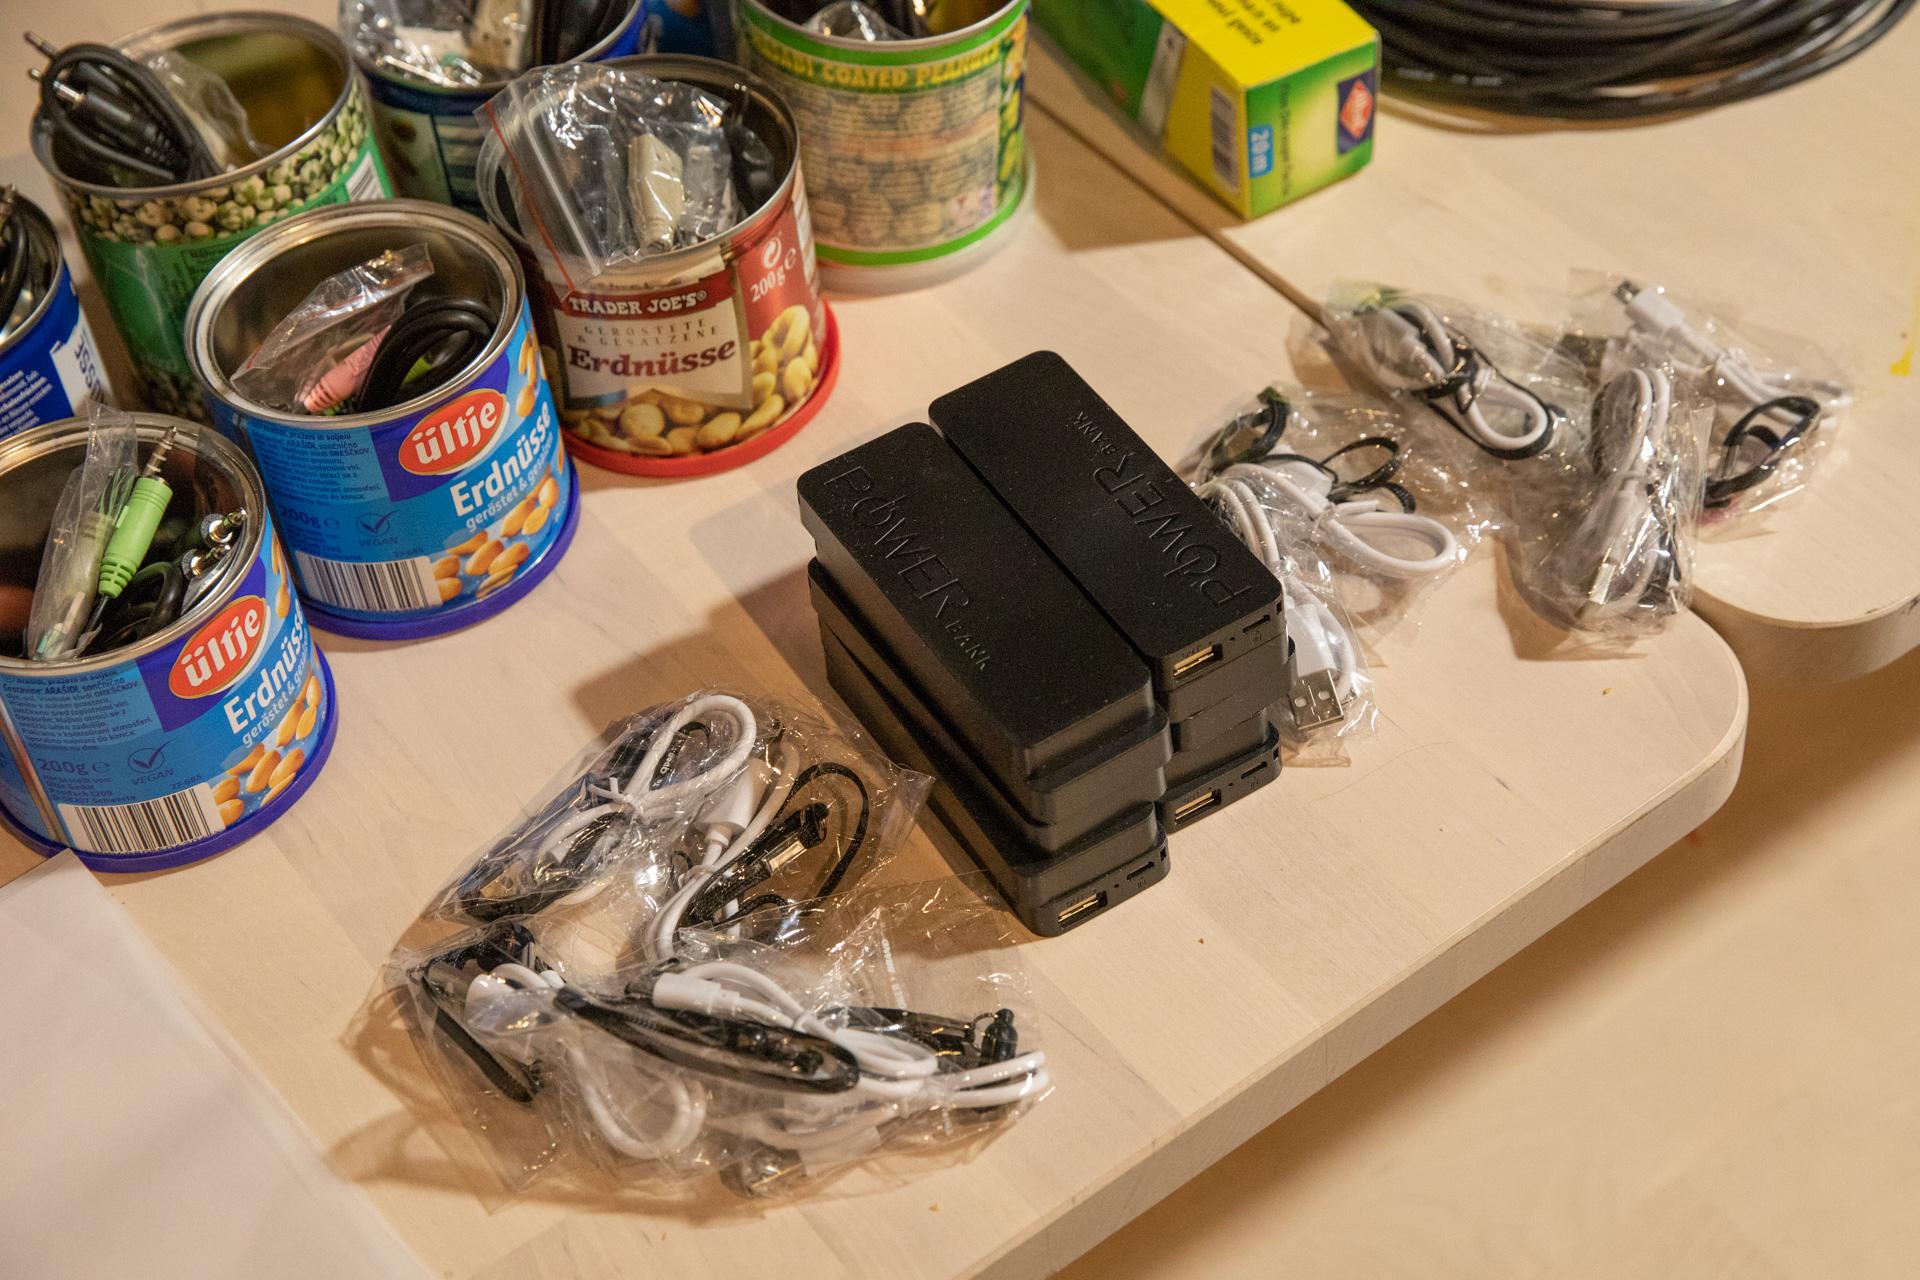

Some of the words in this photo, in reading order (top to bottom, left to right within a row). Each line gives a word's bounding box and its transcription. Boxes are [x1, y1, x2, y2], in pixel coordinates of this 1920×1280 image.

[822, 64, 909, 88] COATED
[568, 296, 643, 316] TRADER
[567, 340, 736, 377] Erdnüsse
[412, 401, 498, 465] ültje
[1073, 411, 1116, 455] BANK
[450, 401, 551, 517] Erdnüsse
[279, 505, 321, 529] 200g
[466, 486, 519, 533] geröstet
[519, 477, 529, 491] &
[1093, 450, 1253, 606] POWER
[359, 536, 398, 547] VEGAN
[823, 465, 970, 620] POWER
[944, 619, 991, 671] BANK
[181, 608, 261, 688] ültje
[223, 598, 304, 735] Erdnüsse
[242, 691, 289, 749] geröstet
[287, 681, 296, 695] &
[37, 757, 89, 776] 200g
[131, 768, 174, 785] VEGAN
